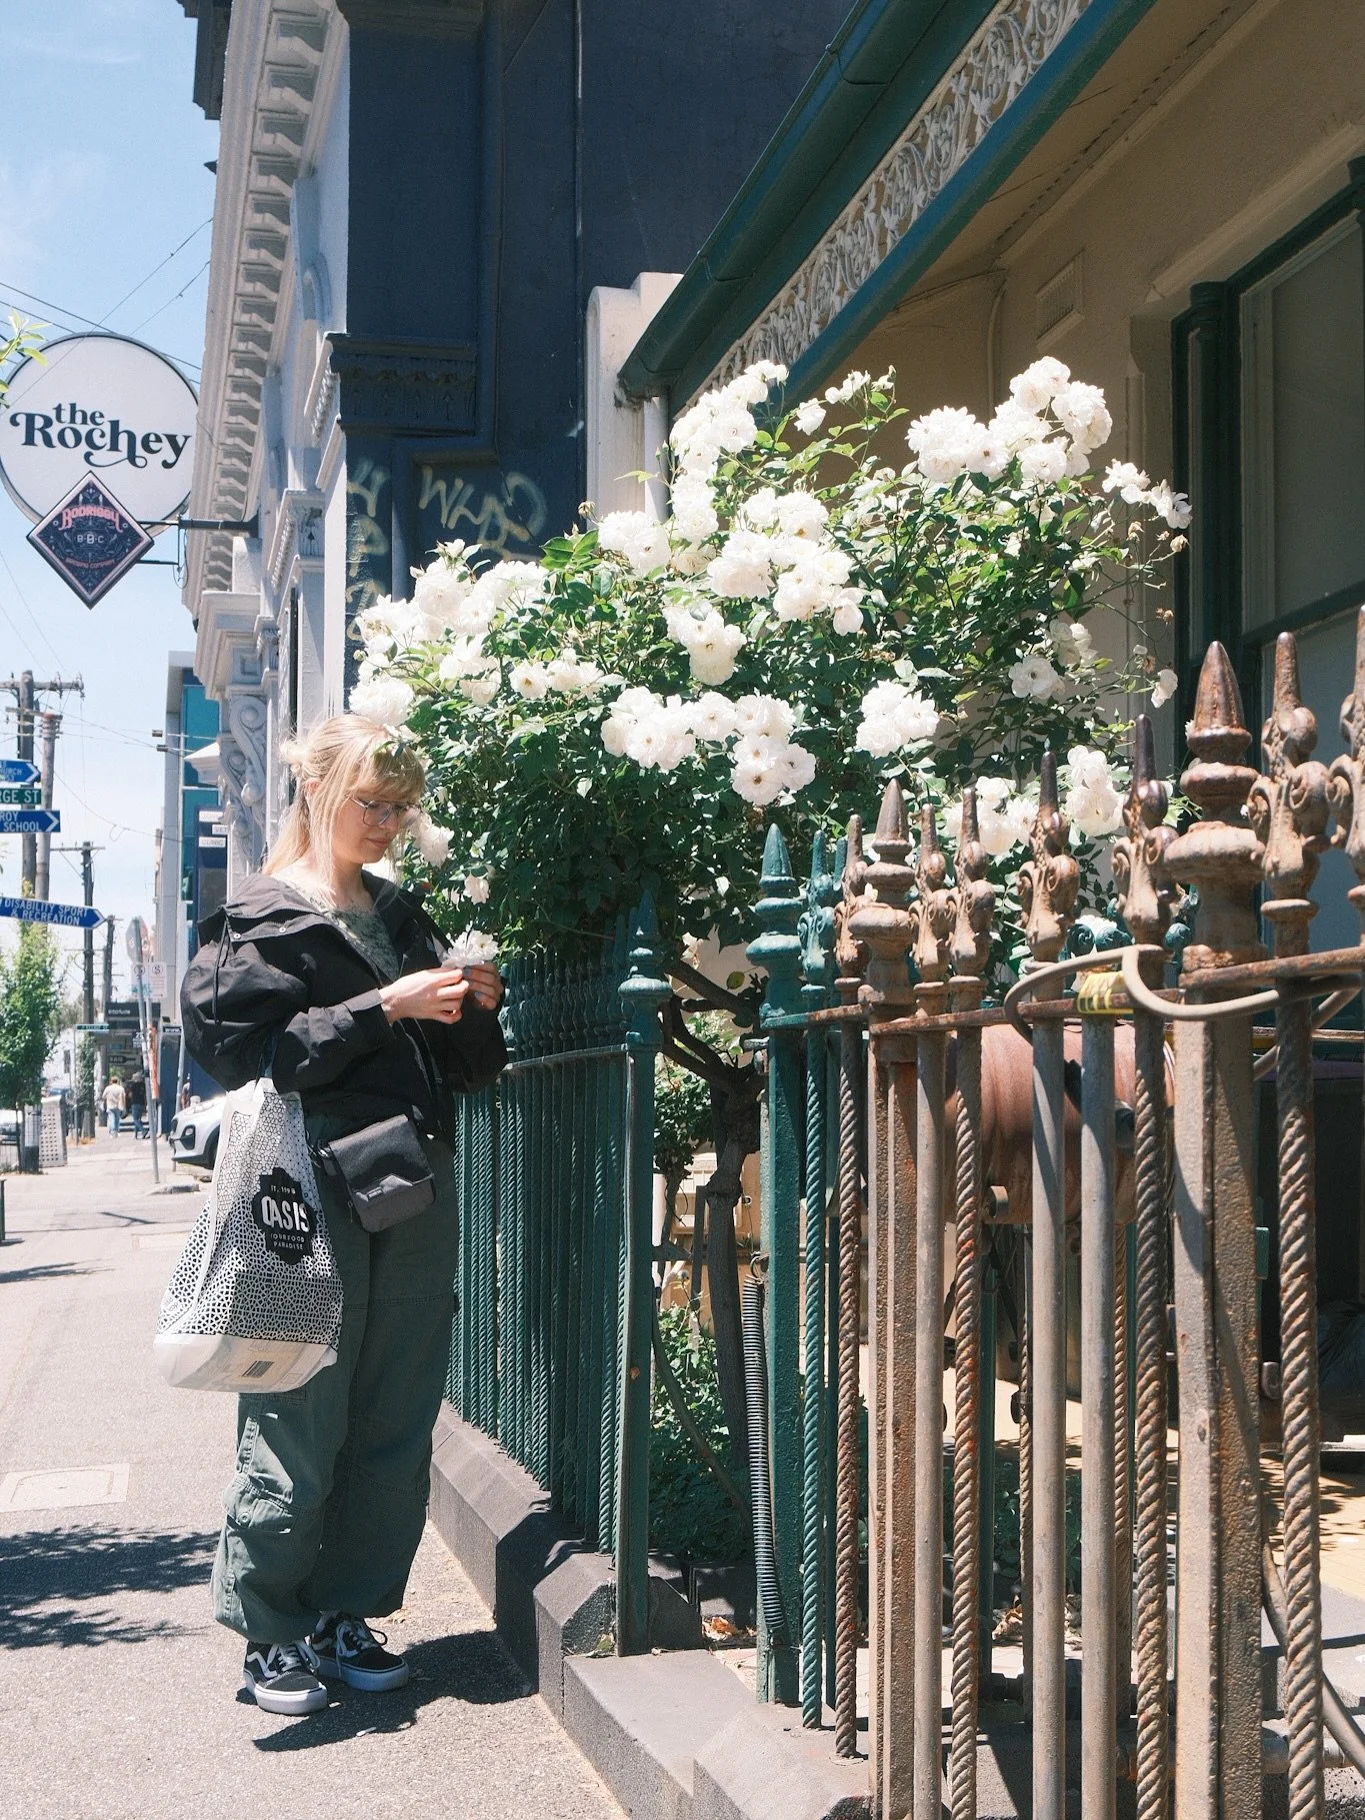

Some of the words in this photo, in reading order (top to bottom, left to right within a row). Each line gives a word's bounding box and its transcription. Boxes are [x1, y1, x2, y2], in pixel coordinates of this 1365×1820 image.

[52, 403, 105, 426] the
[9, 412, 192, 469] Rochey
[0, 790, 19, 804] GE
[24, 790, 39, 804] ST
[3, 821, 42, 833] SCHOOL
[4, 898, 55, 912] DISABILITY
[58, 906, 88, 917] SPORT
[11, 908, 18, 917] &
[22, 910, 80, 926] RECREATION
[261, 1195, 310, 1233] OASIS
